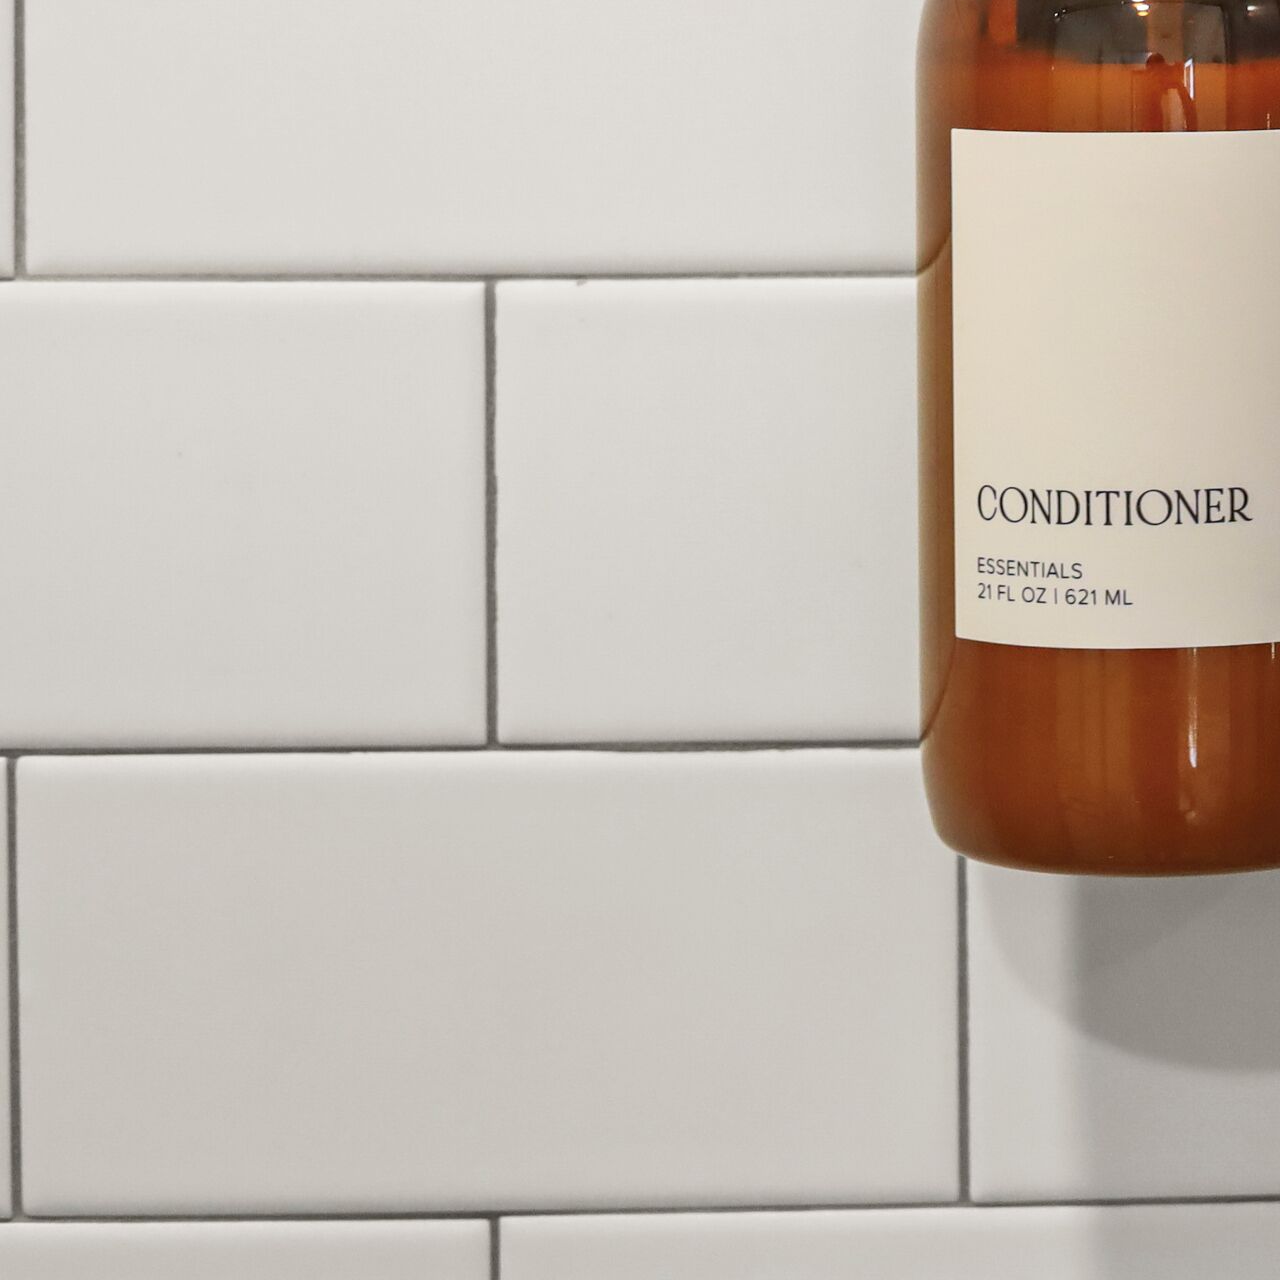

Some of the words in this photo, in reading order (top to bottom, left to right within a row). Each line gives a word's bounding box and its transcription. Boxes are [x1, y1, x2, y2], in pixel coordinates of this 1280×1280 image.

[977, 484, 1254, 527] CONDITIONER
[977, 556, 1083, 580] ESSENTIALS
[977, 582, 992, 600] 21
[997, 584, 1016, 602] FL
[1021, 586, 1047, 604] OZ
[1064, 588, 1097, 606] 621
[1104, 589, 1134, 606] ML
